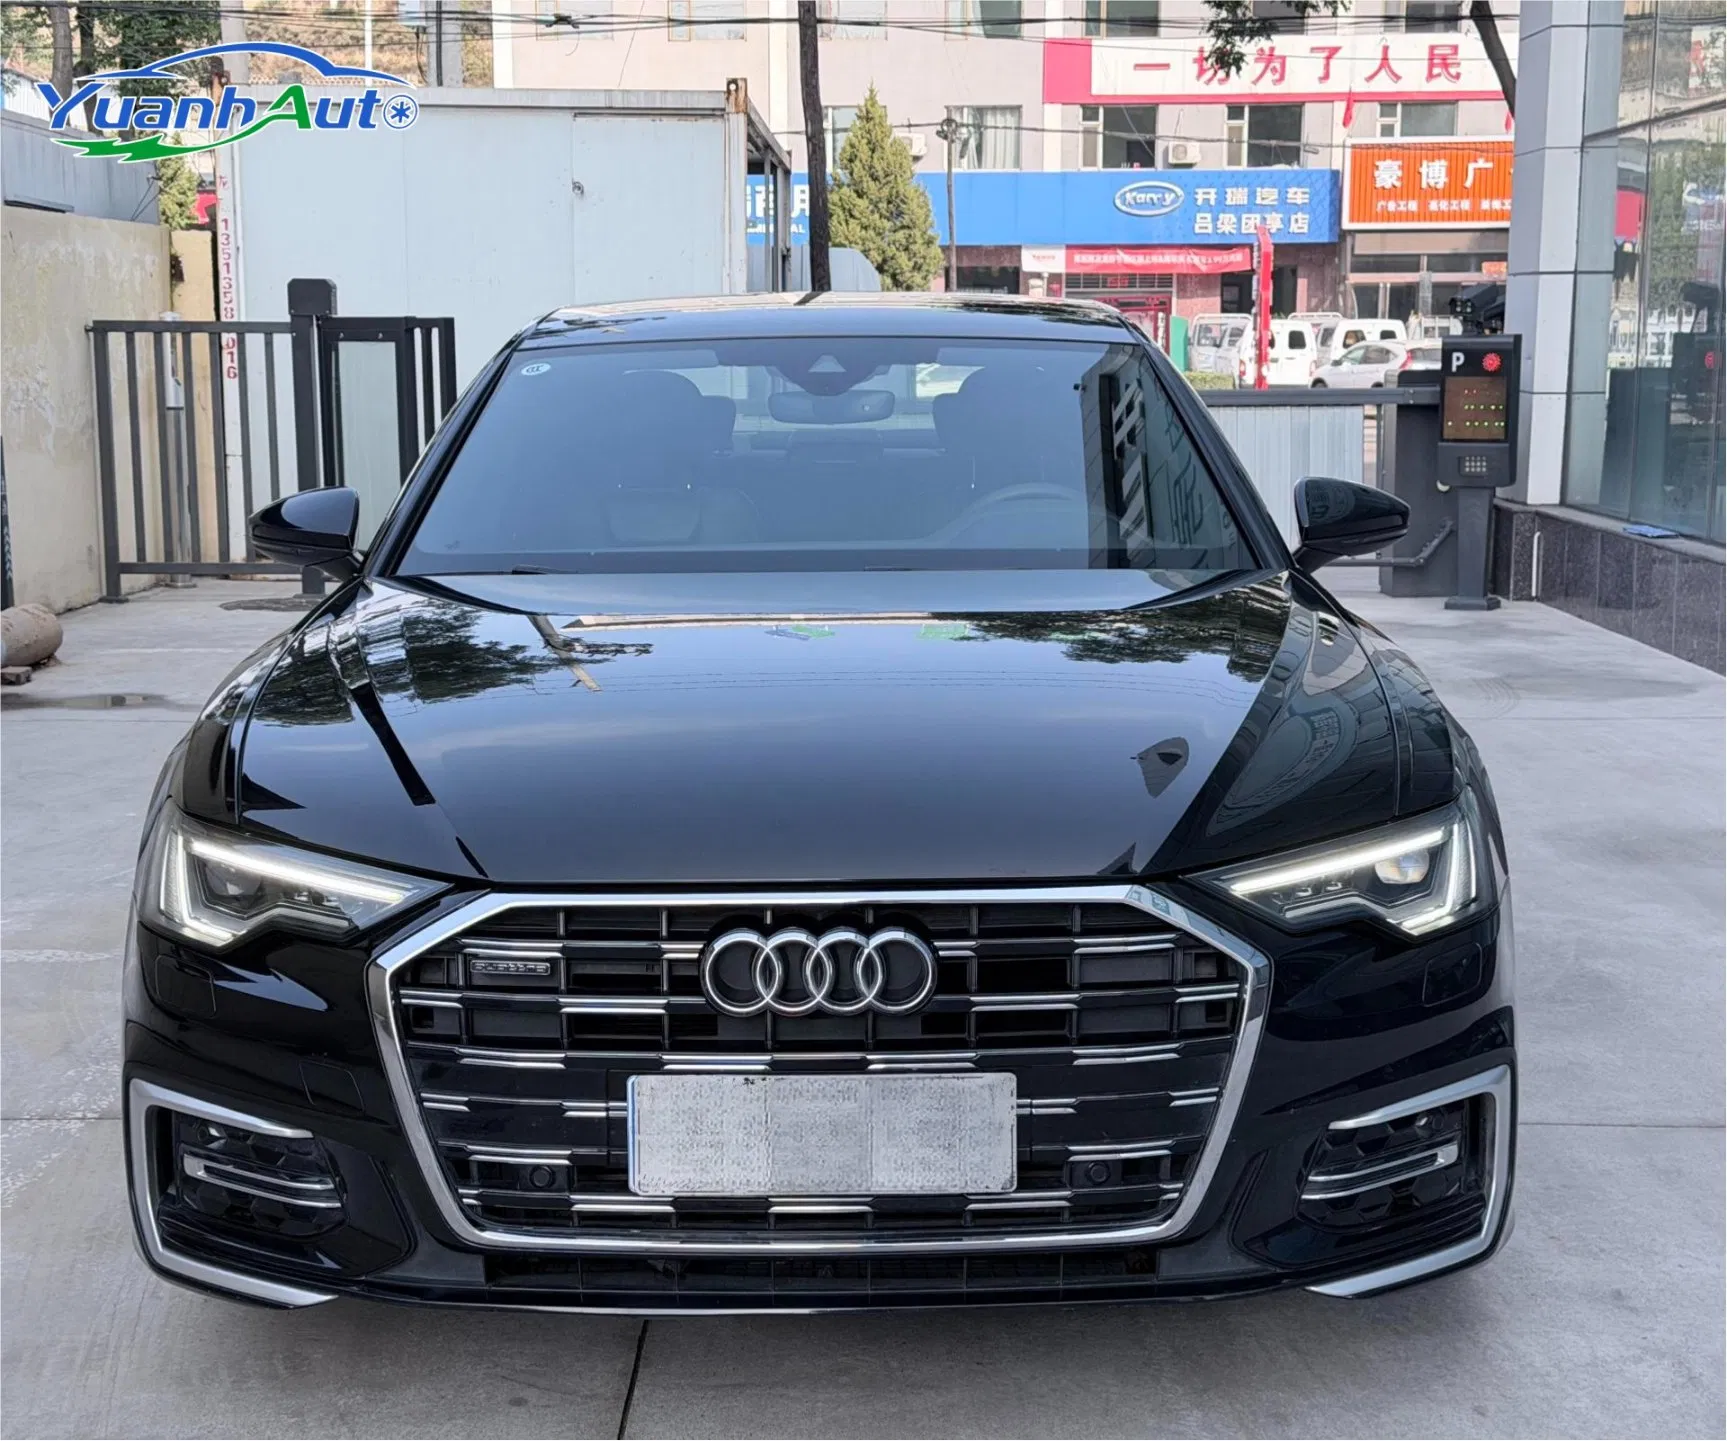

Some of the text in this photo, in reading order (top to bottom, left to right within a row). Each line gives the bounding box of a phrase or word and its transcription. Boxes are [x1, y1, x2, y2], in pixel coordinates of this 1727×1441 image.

[1374, 157, 1513, 190] 豪博广
[1194, 187, 1310, 206] 开瑞汽车
[221, 218, 238, 380] 1351358016
[1451, 351, 1465, 373] P
